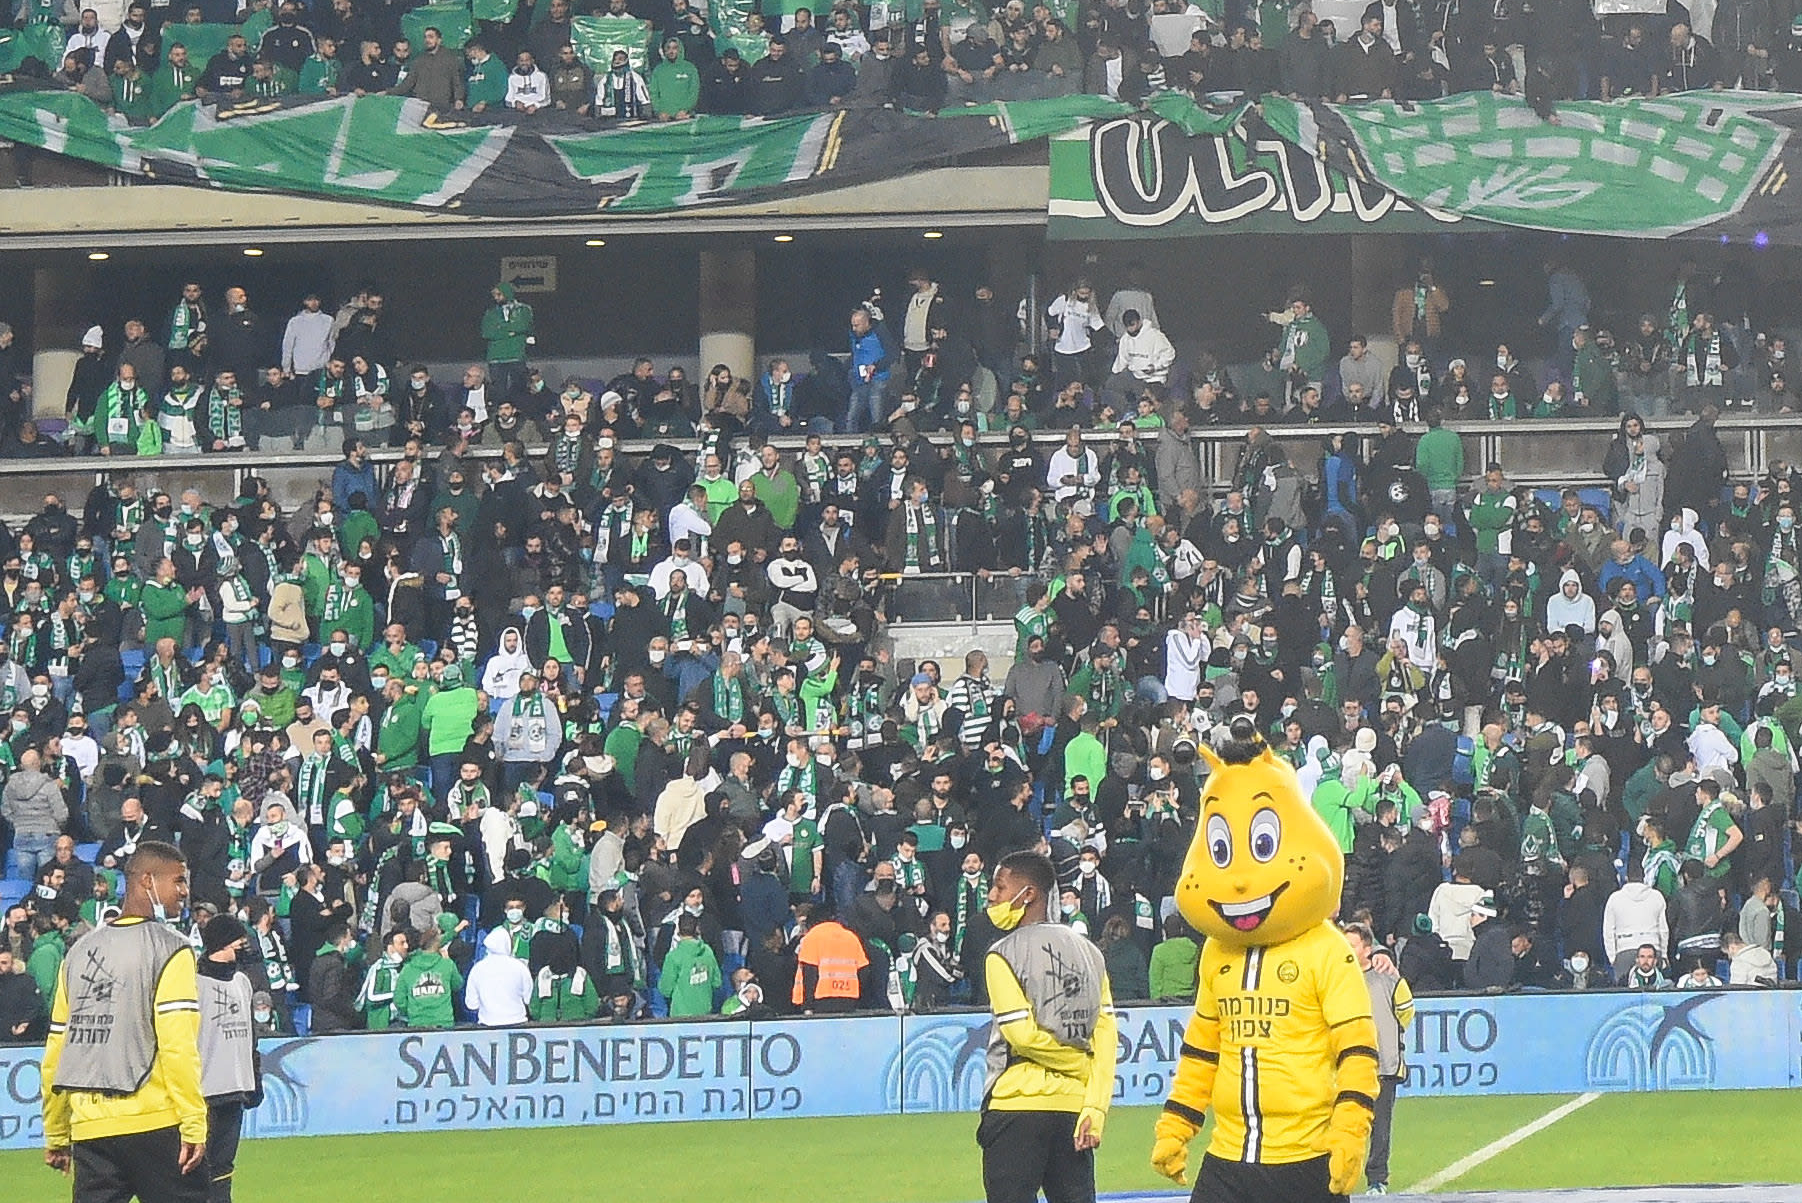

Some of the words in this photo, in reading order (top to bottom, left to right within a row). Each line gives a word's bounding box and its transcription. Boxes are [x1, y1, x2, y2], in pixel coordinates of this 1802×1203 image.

[1218, 996, 1290, 1017] פנורמה
[1229, 1019, 1272, 1042] צפון
[1403, 1062, 1498, 1088] פסגת
[383, 1094, 565, 1126] מהאלפים.
[582, 1090, 684, 1123] המים,
[701, 1085, 802, 1115] פסגת
